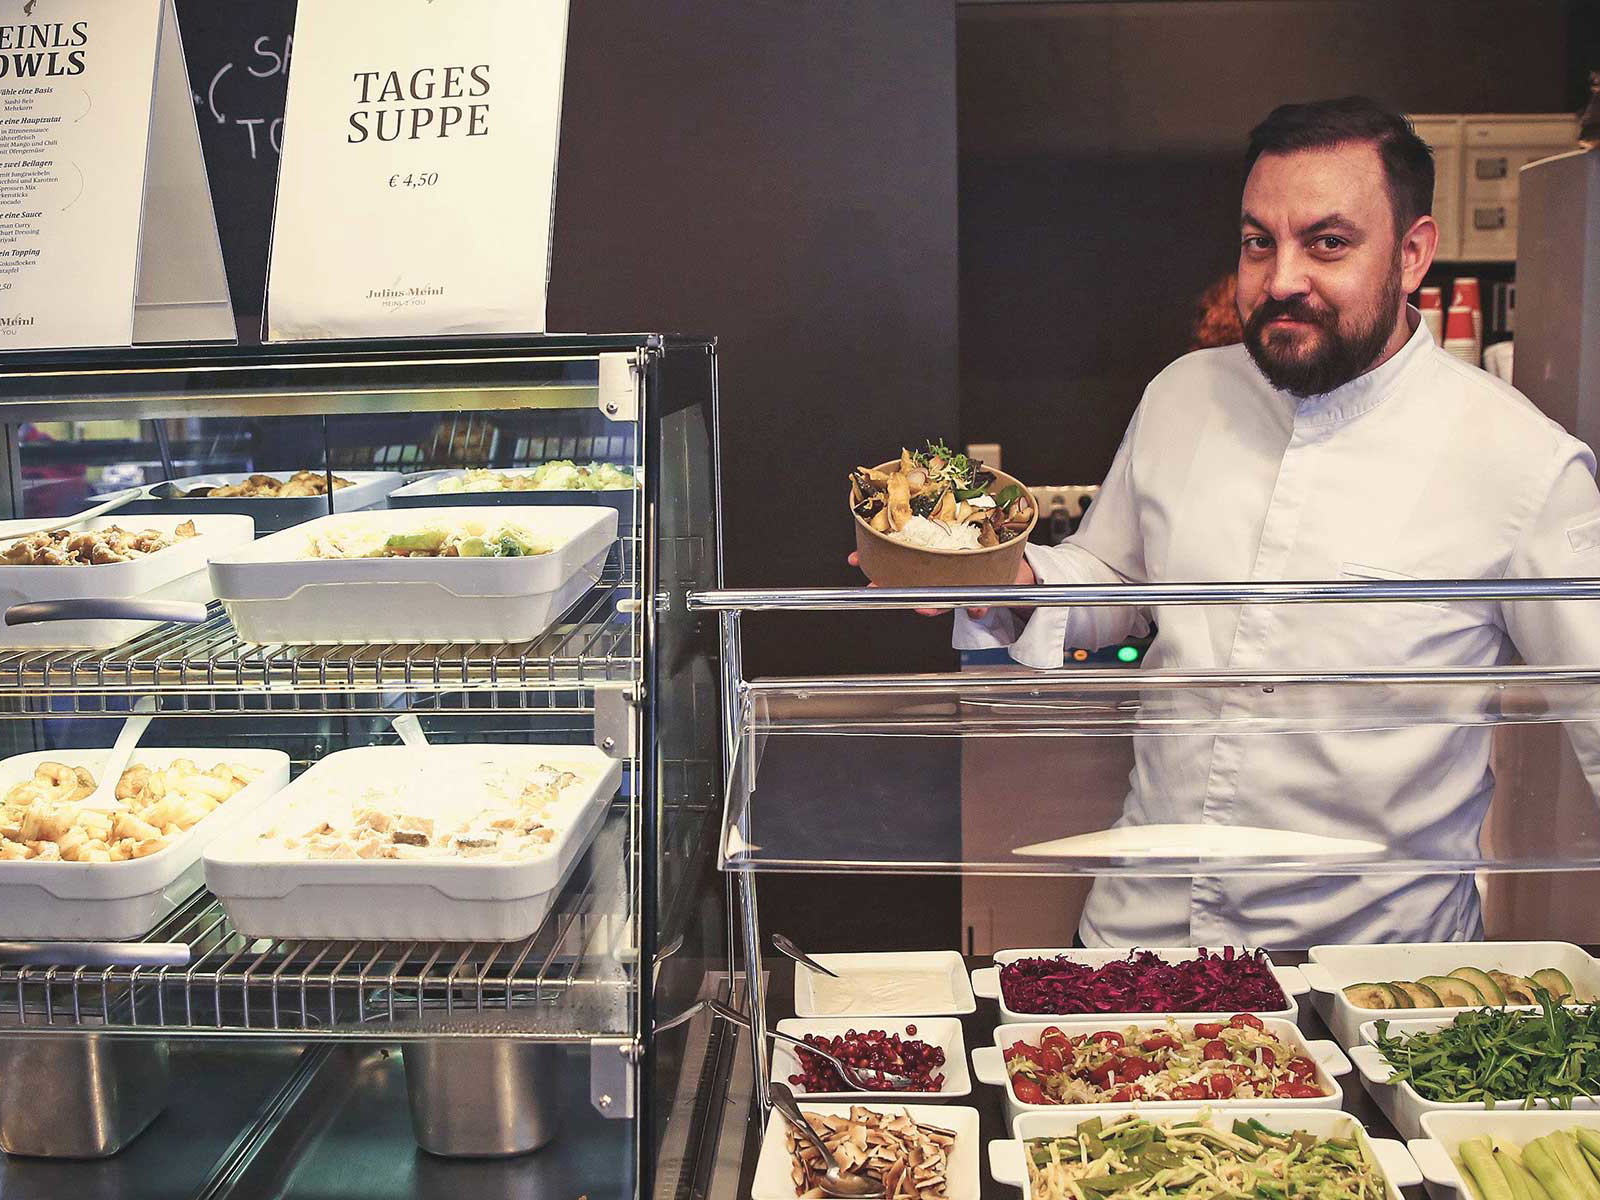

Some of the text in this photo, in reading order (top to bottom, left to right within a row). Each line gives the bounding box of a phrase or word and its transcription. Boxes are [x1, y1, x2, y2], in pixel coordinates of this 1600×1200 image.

[353, 64, 491, 104] TAGES
[34, 87, 54, 95] Basis
[20, 116, 62, 125] Hauptzutat
[347, 104, 490, 144] SUPPE
[10, 141, 31, 149] Mango
[8, 147, 45, 155] Ofengemüse
[22, 160, 53, 169] Beilagen
[11, 170, 51, 179] Jungzwiebeln
[389, 172, 439, 189] € 4,50
[4, 211, 21, 219] eine
[20, 210, 43, 218] Sauce
[14, 228, 41, 236] Dressing
[11, 248, 41, 258] Topping
[366, 286, 444, 299] Julius Meinl
